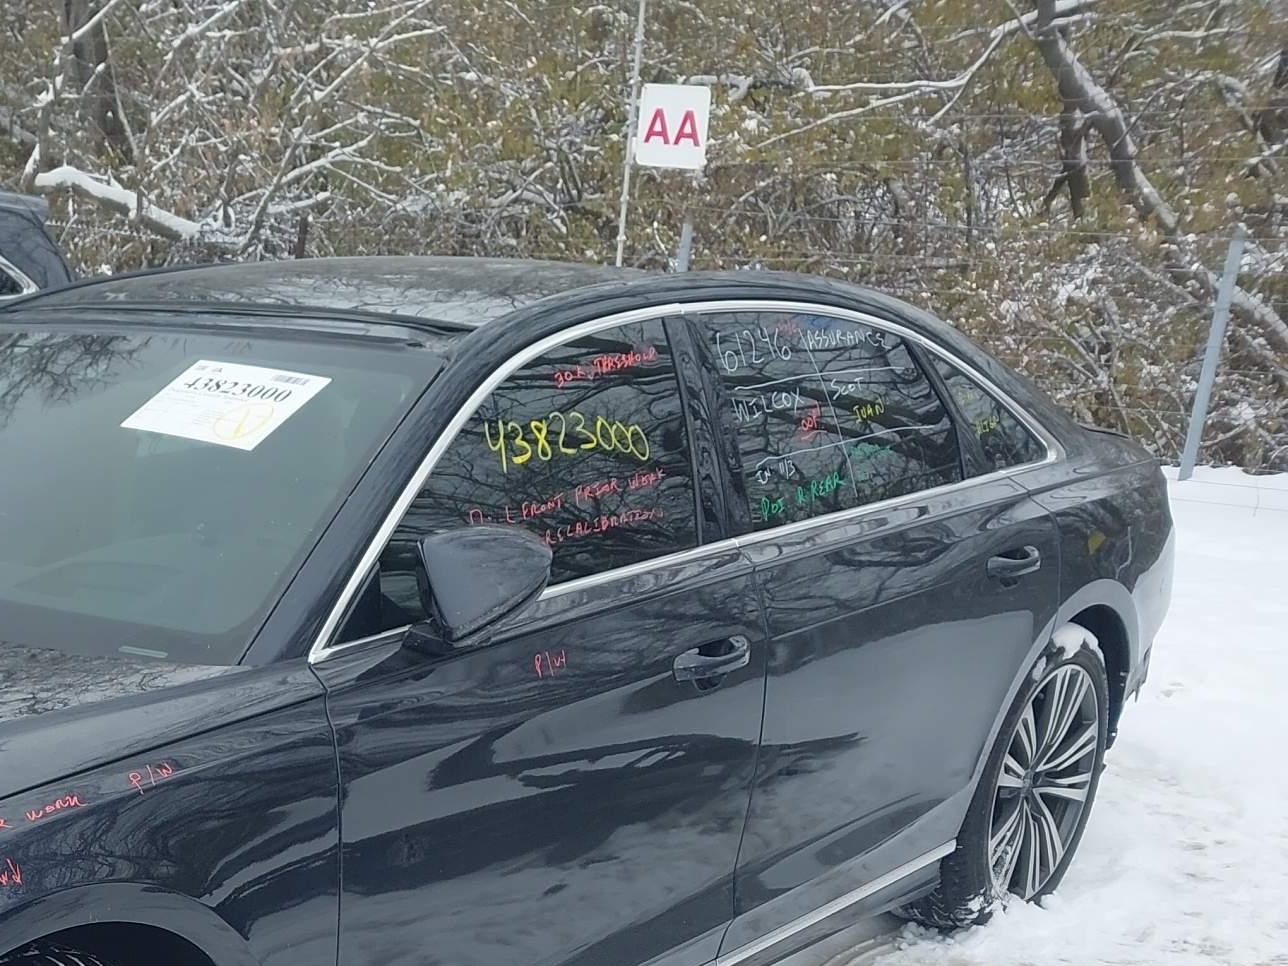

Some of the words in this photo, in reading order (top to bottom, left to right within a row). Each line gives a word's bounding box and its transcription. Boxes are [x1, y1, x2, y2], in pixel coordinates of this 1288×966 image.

[643, 108, 700, 147] AA
[716, 327, 792, 373] 61246
[184, 377, 293, 402] 43823000
[485, 411, 649, 473] 43823000
[521, 493, 564, 520] FRONT
[575, 478, 622, 507] PRIOR
[811, 471, 847, 502] REAR
